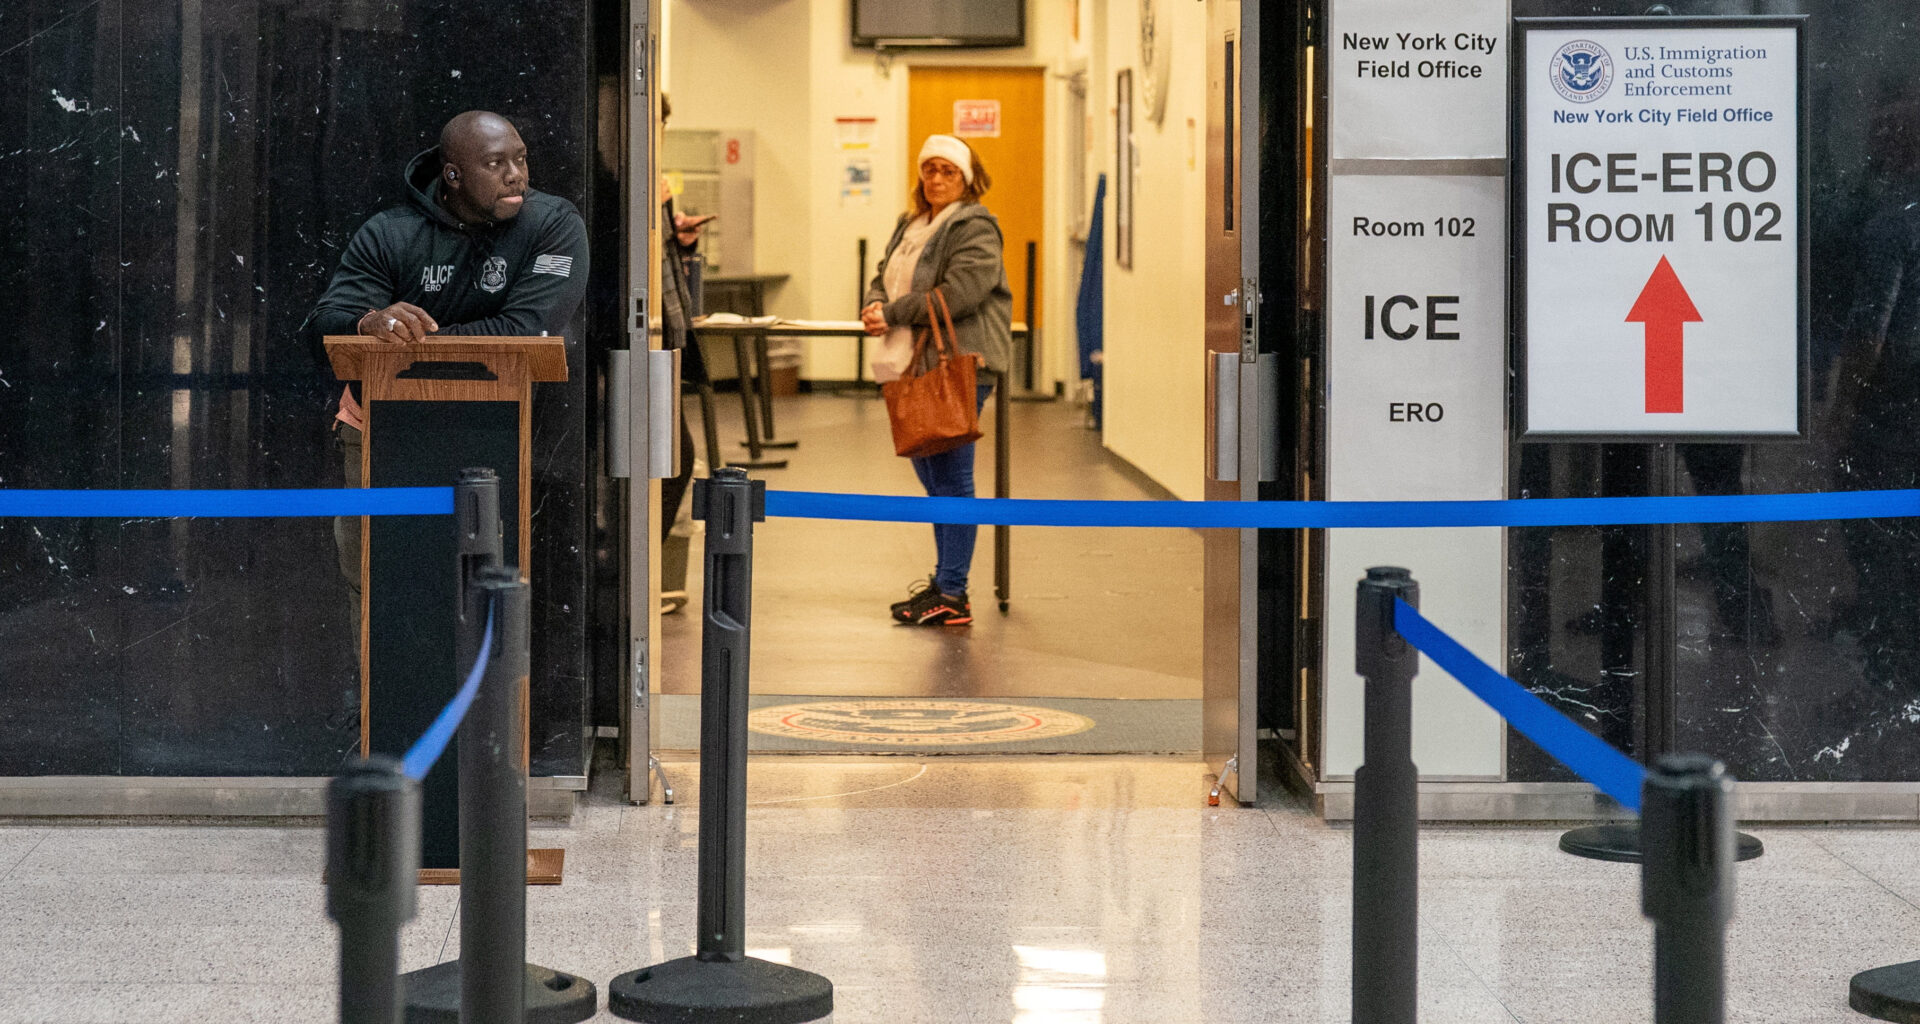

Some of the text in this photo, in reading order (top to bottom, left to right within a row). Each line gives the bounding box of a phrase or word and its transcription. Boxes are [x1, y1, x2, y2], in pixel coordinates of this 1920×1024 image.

[1343, 32, 1498, 56] New York City
[1624, 45, 1767, 61] U.S. Immigration
[1357, 60, 1483, 79] Field Office
[1624, 63, 1733, 78] and Customs
[1552, 74, 1584, 101] HOMELAND
[1624, 80, 1732, 97] Enforcement
[1553, 108, 1774, 126] New York City Field Office
[725, 138, 741, 165] 8
[1551, 151, 1777, 195] ICE-ERO
[1353, 216, 1477, 238] Room 102
[1694, 202, 1782, 243] 102
[424, 283, 442, 292] ERO
[1364, 294, 1461, 341] ICE
[1389, 402, 1444, 423] ERO
